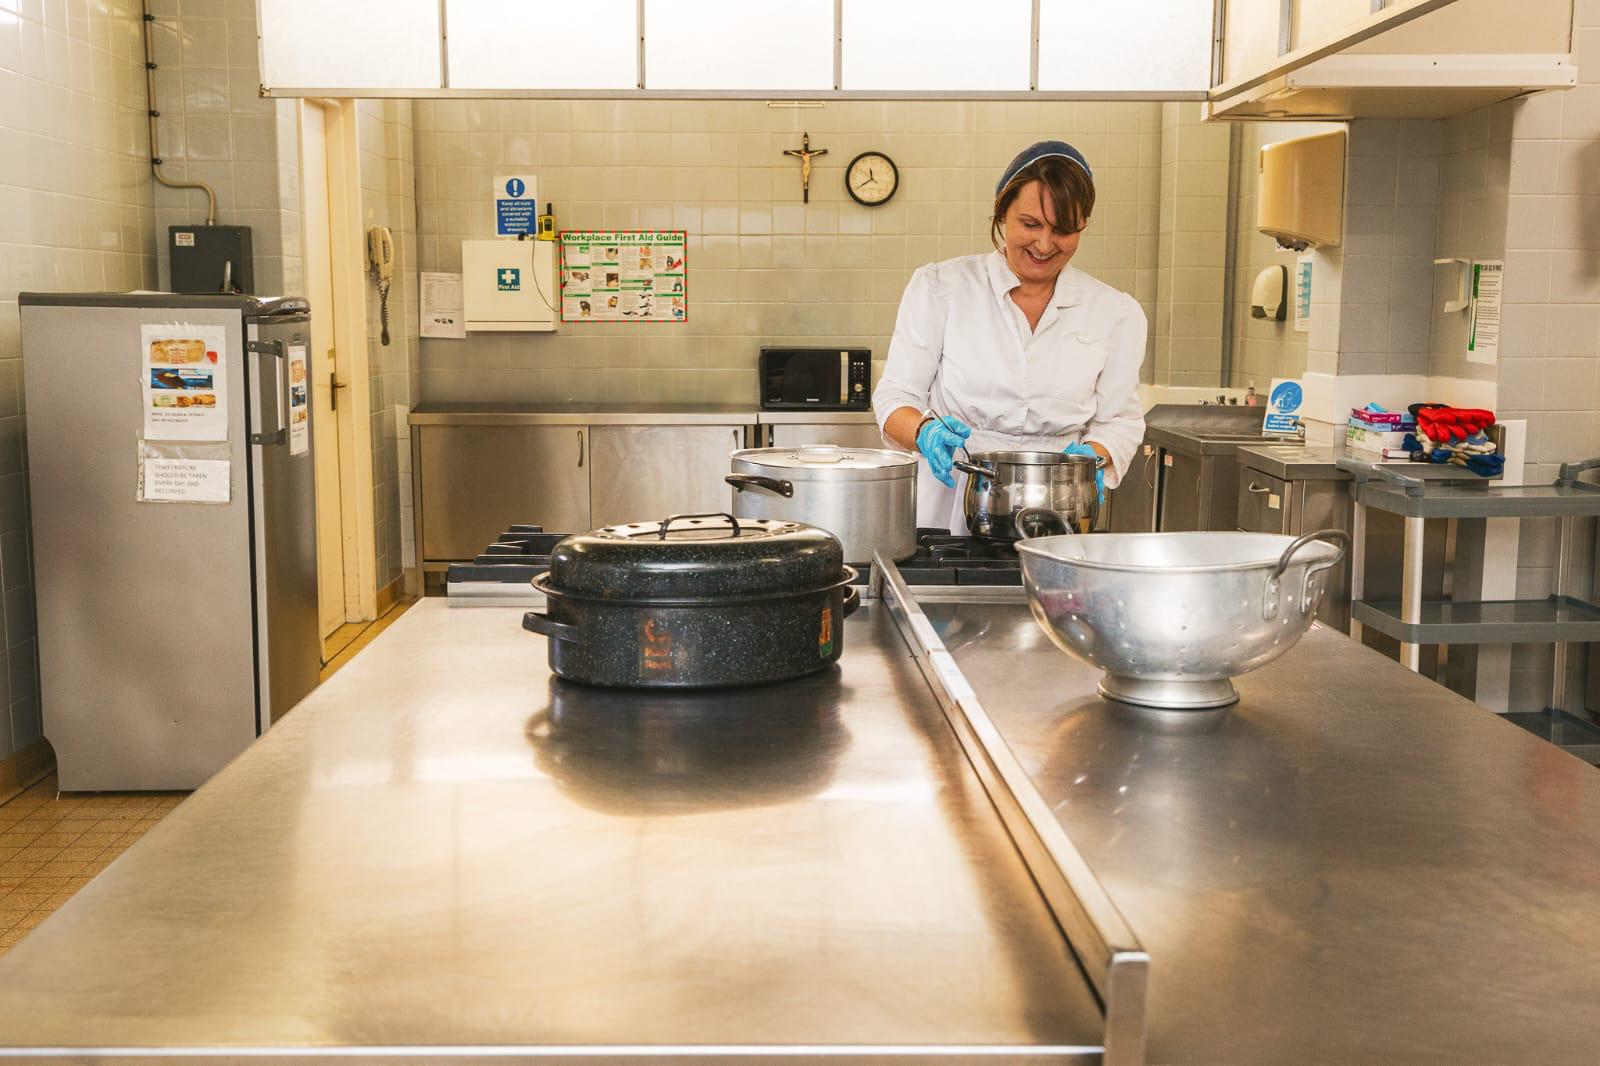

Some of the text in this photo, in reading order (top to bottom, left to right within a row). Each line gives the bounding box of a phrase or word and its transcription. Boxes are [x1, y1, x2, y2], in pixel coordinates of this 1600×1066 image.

[563, 233, 683, 242] Workplace First Aid Guide
[188, 472, 208, 480] TAKEN
[186, 480, 201, 488] AND
